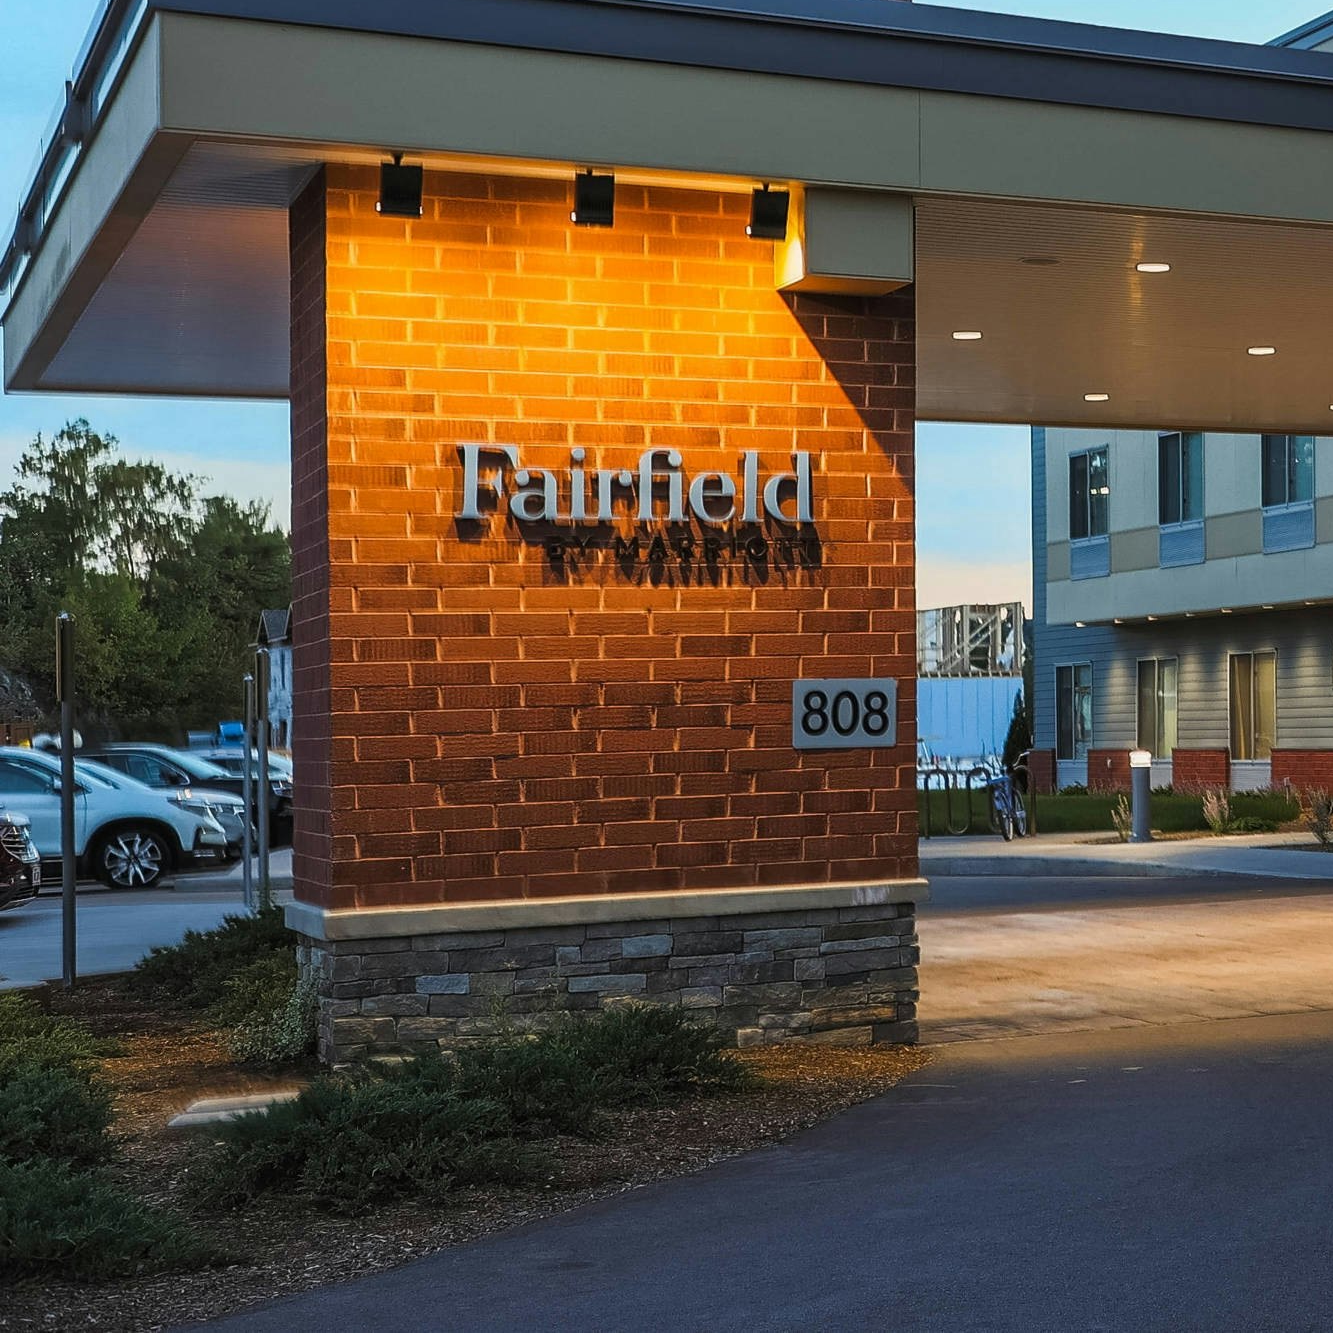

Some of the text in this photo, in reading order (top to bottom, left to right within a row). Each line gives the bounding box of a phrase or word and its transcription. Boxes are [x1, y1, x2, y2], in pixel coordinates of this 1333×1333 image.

[455, 444, 815, 523] Fairfield
[548, 535, 593, 560] BY
[801, 689, 890, 737] 808
